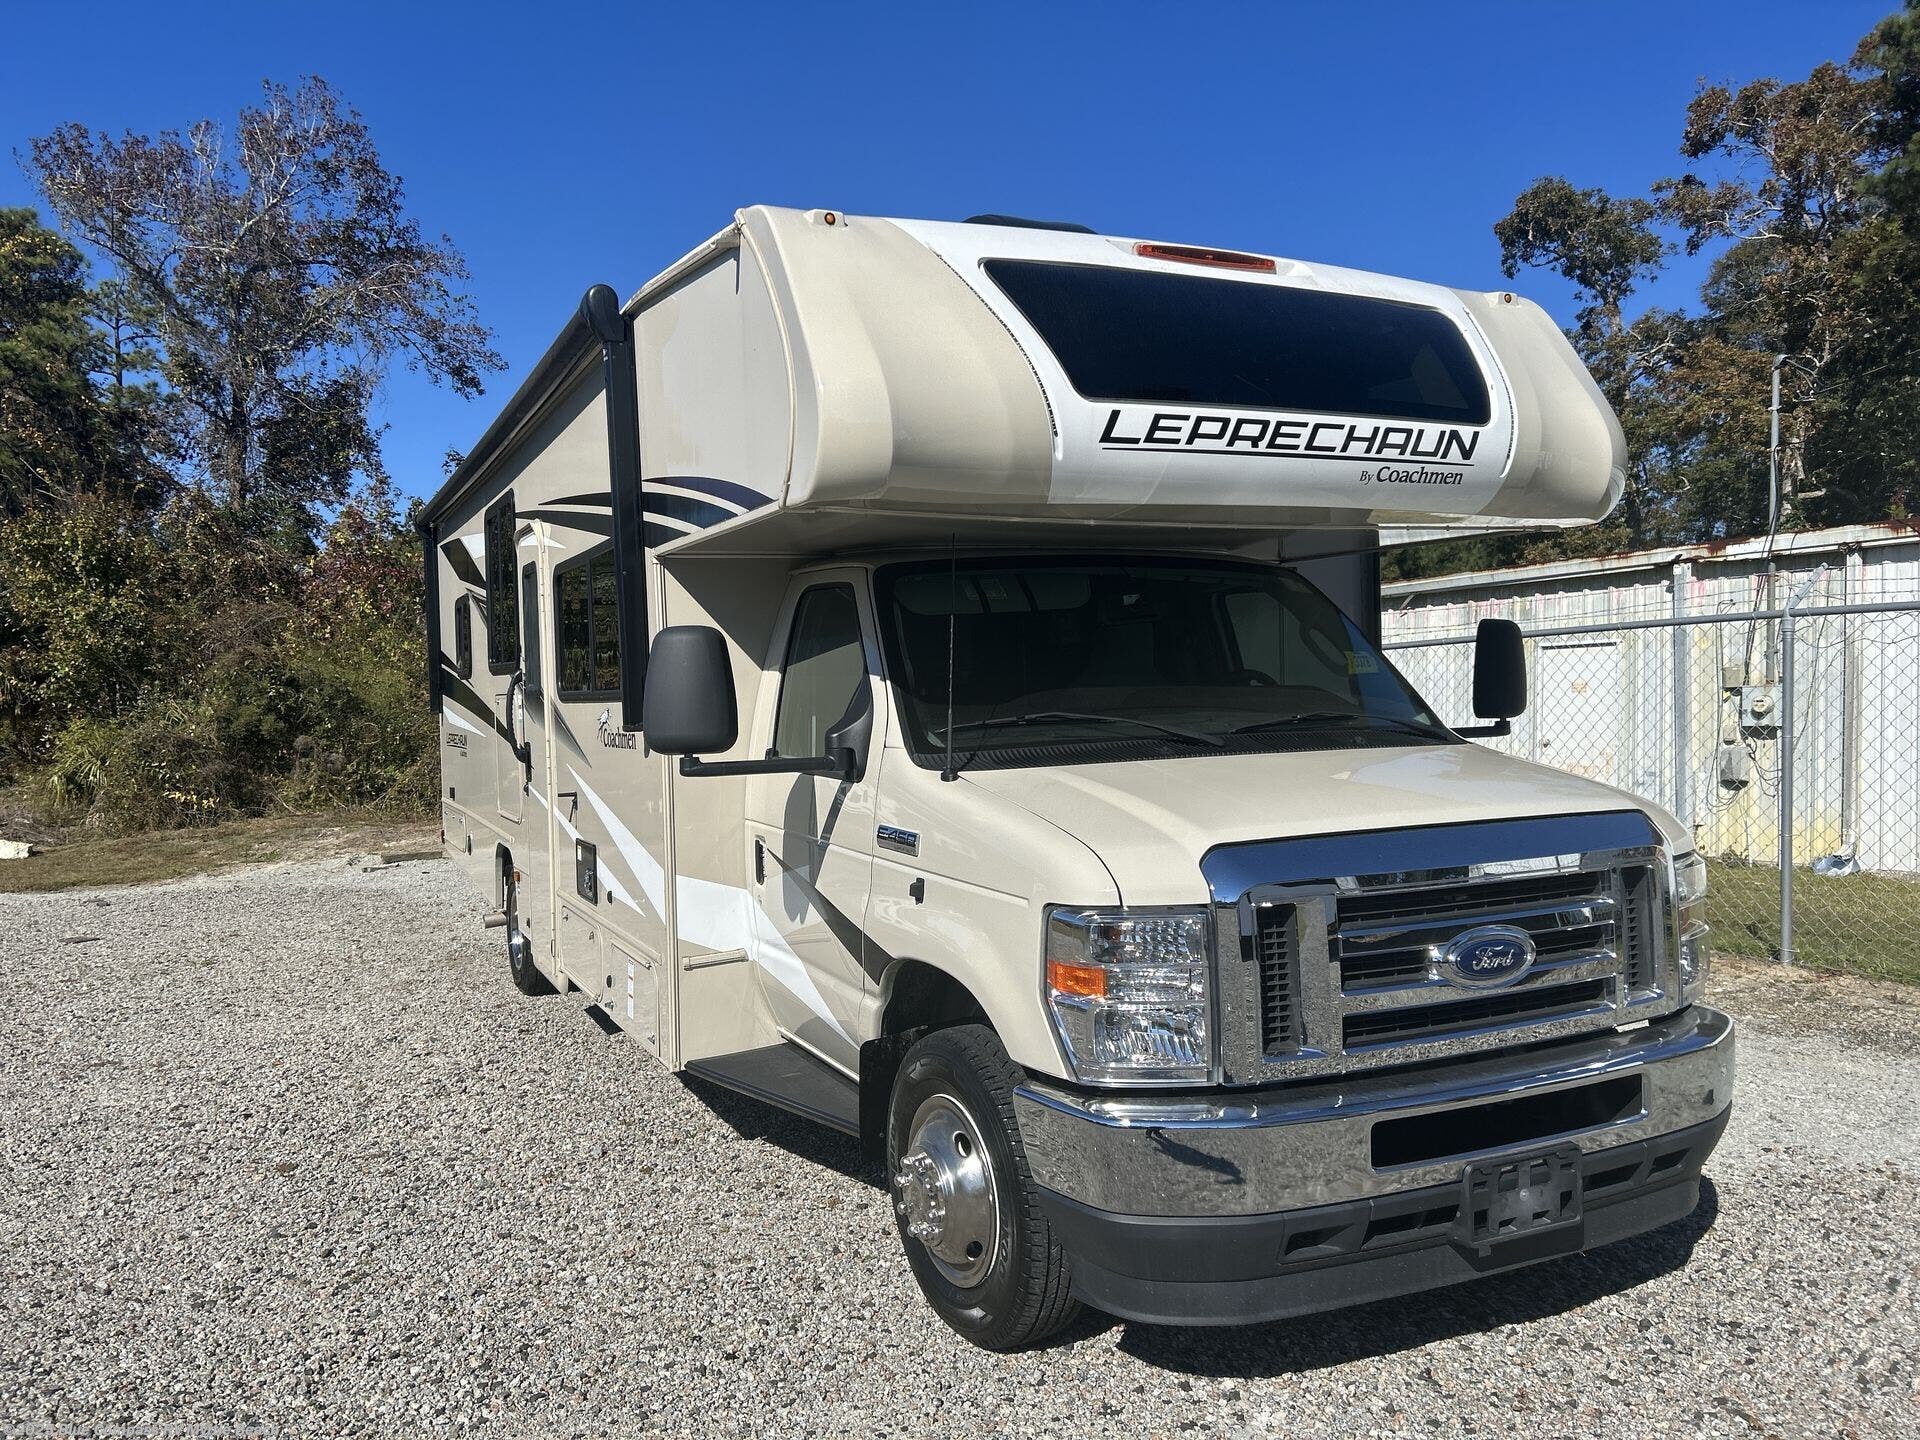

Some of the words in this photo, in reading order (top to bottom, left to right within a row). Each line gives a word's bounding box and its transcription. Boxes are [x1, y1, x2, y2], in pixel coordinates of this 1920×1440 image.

[1099, 409, 1480, 460] LEPRECHAUN
[1360, 470, 1374, 485] By
[1376, 466, 1464, 485] Coachmen
[603, 727, 637, 750] Coachmen
[1472, 945, 1515, 971] Ford
